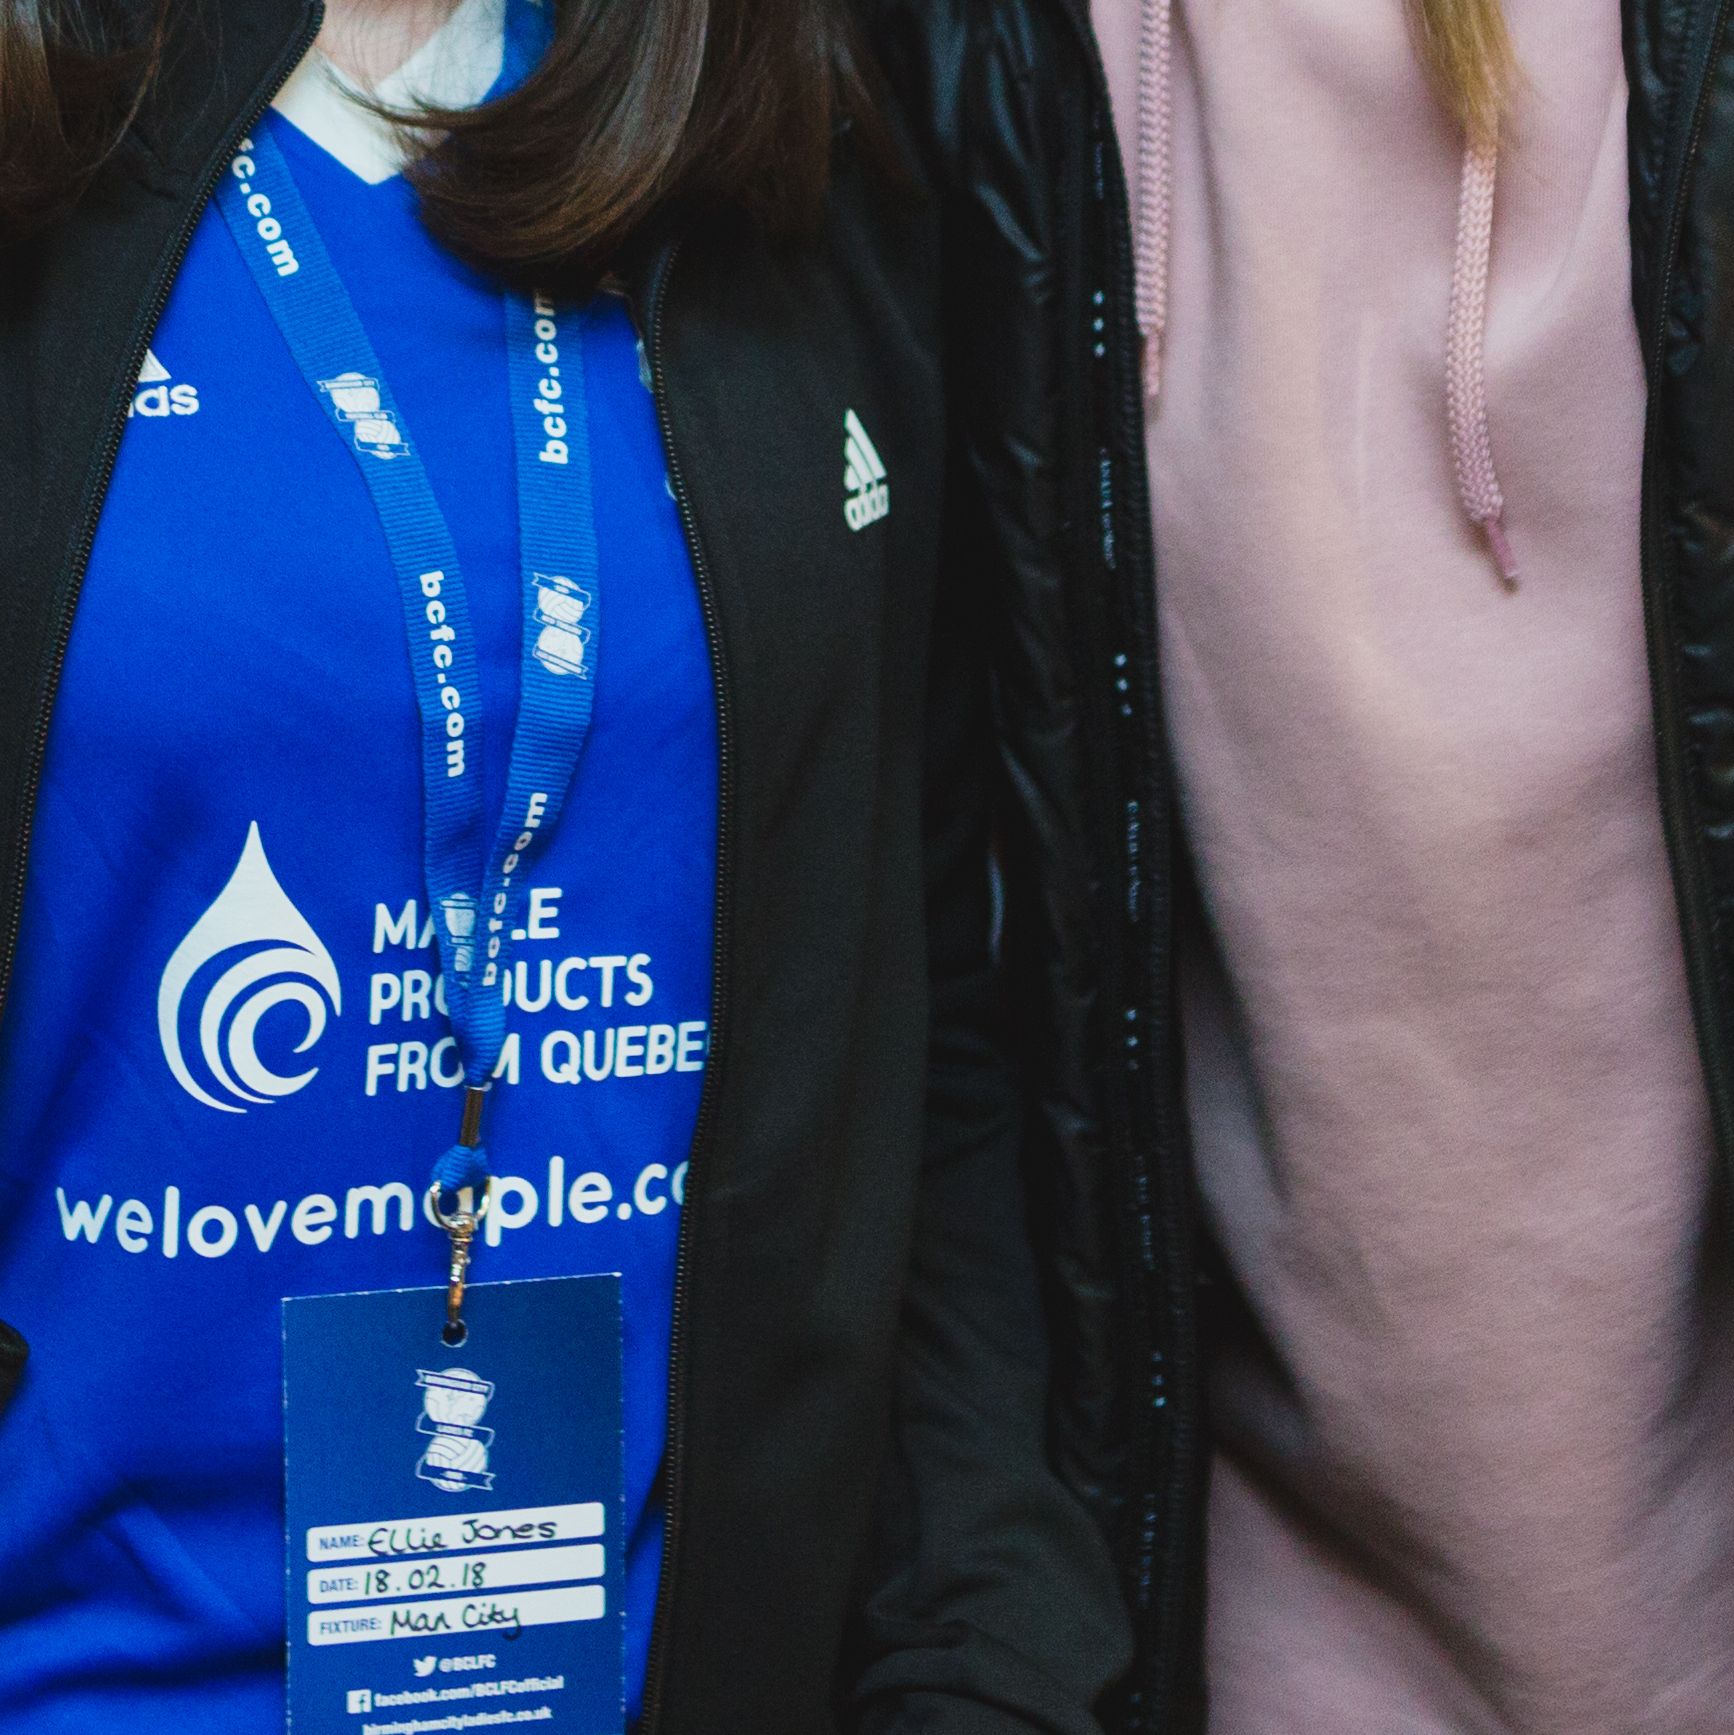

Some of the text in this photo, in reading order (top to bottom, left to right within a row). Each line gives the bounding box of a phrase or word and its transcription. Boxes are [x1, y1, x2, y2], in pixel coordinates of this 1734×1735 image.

[419, 570, 465, 777] bcfc.com
[369, 953, 654, 1025] PRUCTS
[540, 1021, 711, 1086] QUEBE
[319, 1518, 558, 1557] NAME: Ellie Jones
[319, 1561, 487, 1596] DATE: 18.02.18
[319, 1603, 522, 1641] FIXTURE: Man City
[438, 1654, 497, 1672] @BCLFC
